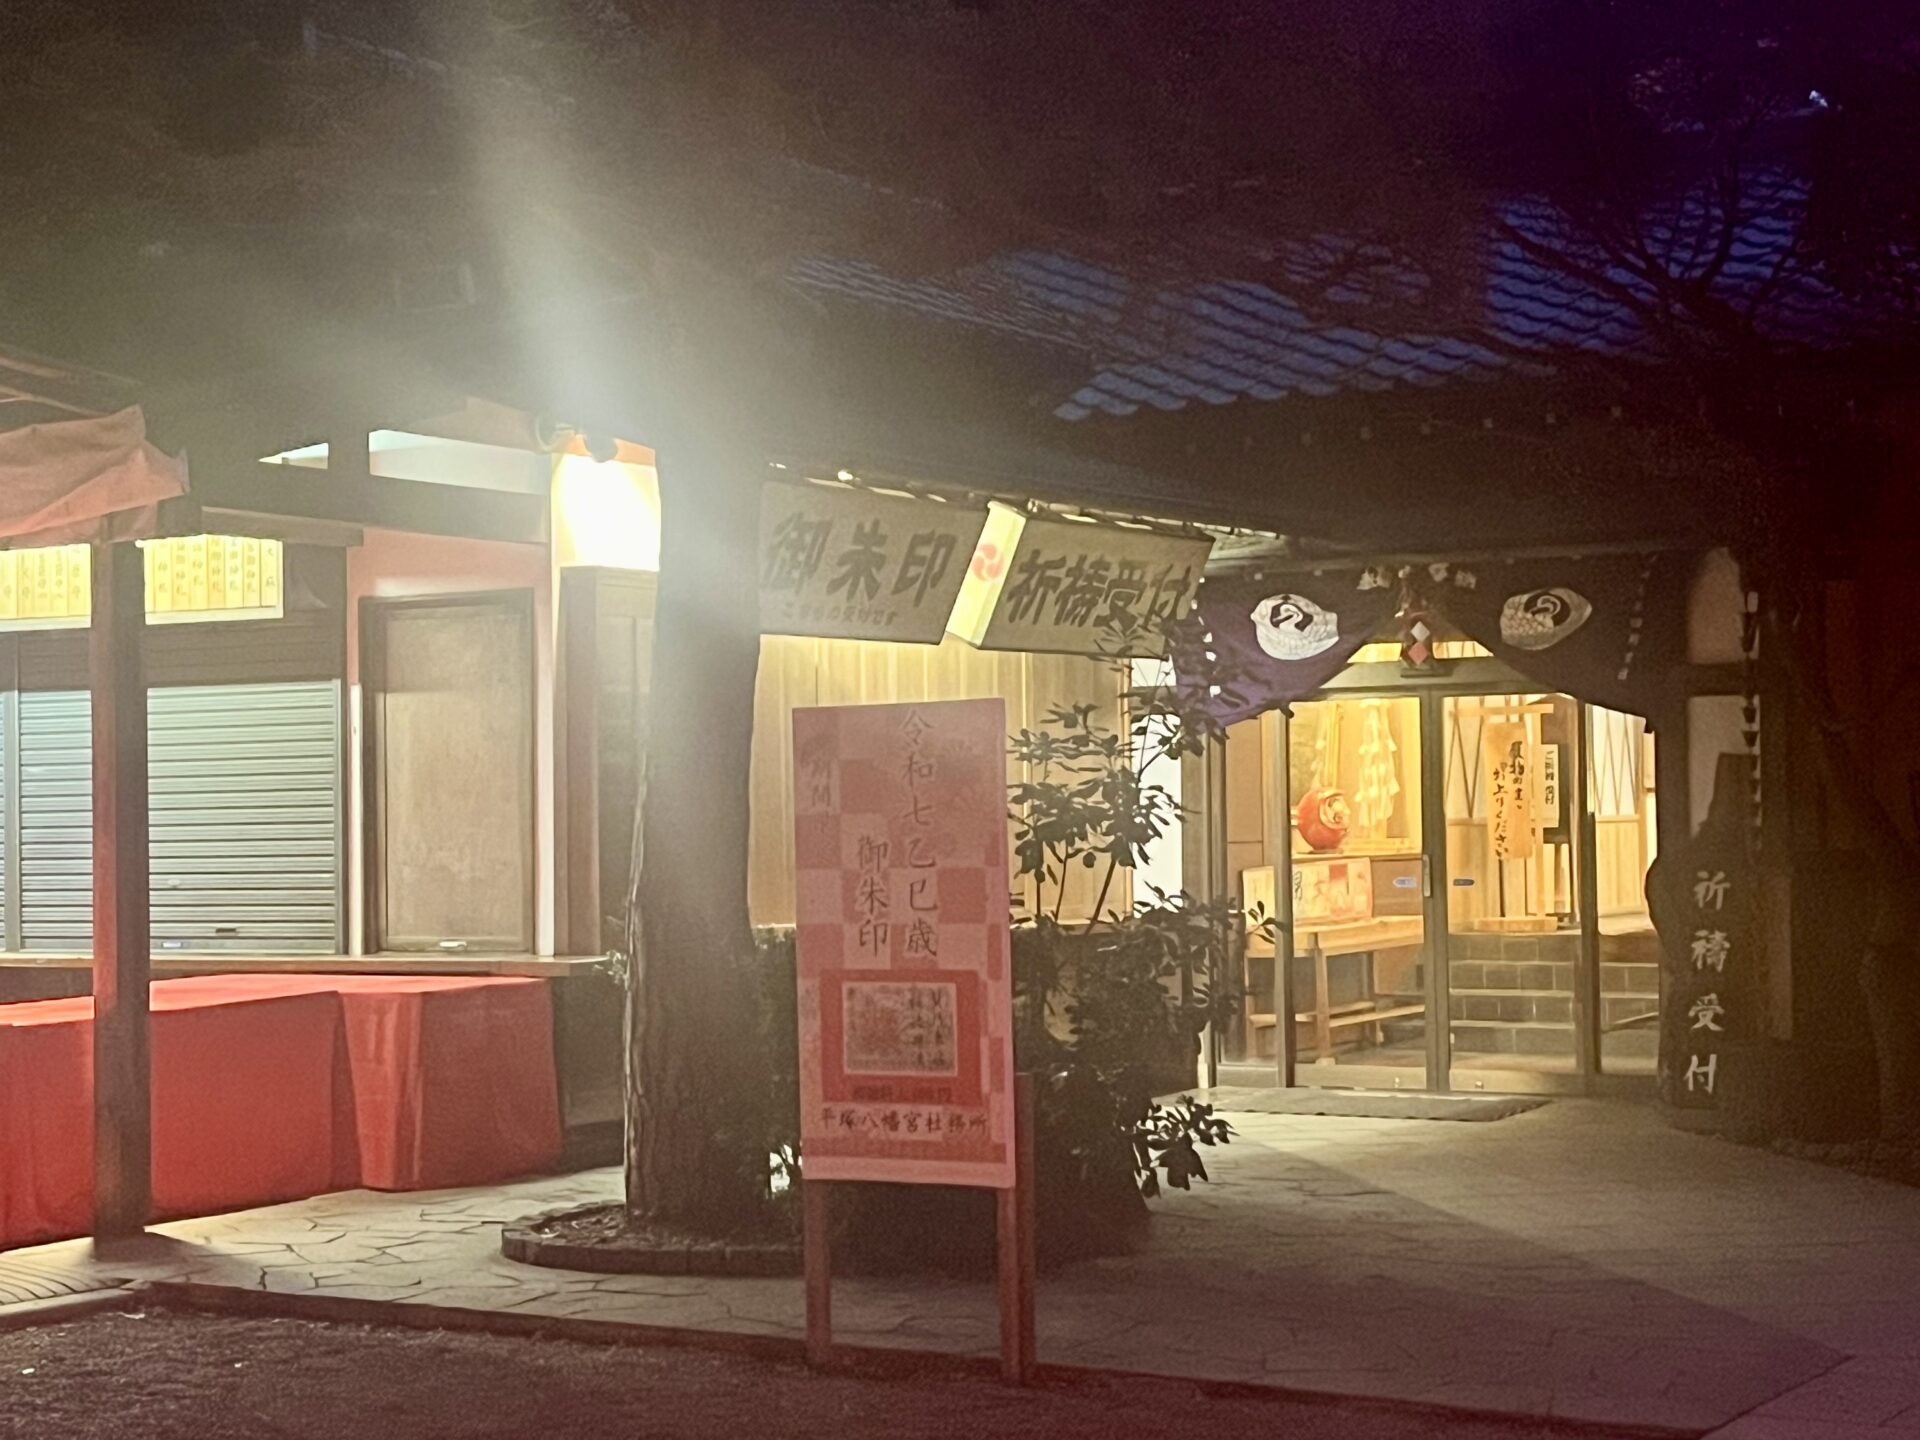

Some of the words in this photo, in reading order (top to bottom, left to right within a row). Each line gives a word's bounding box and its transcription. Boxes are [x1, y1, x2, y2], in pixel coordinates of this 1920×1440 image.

[762, 512, 957, 607] 御朱印
[857, 835, 889, 957] 御朱印
